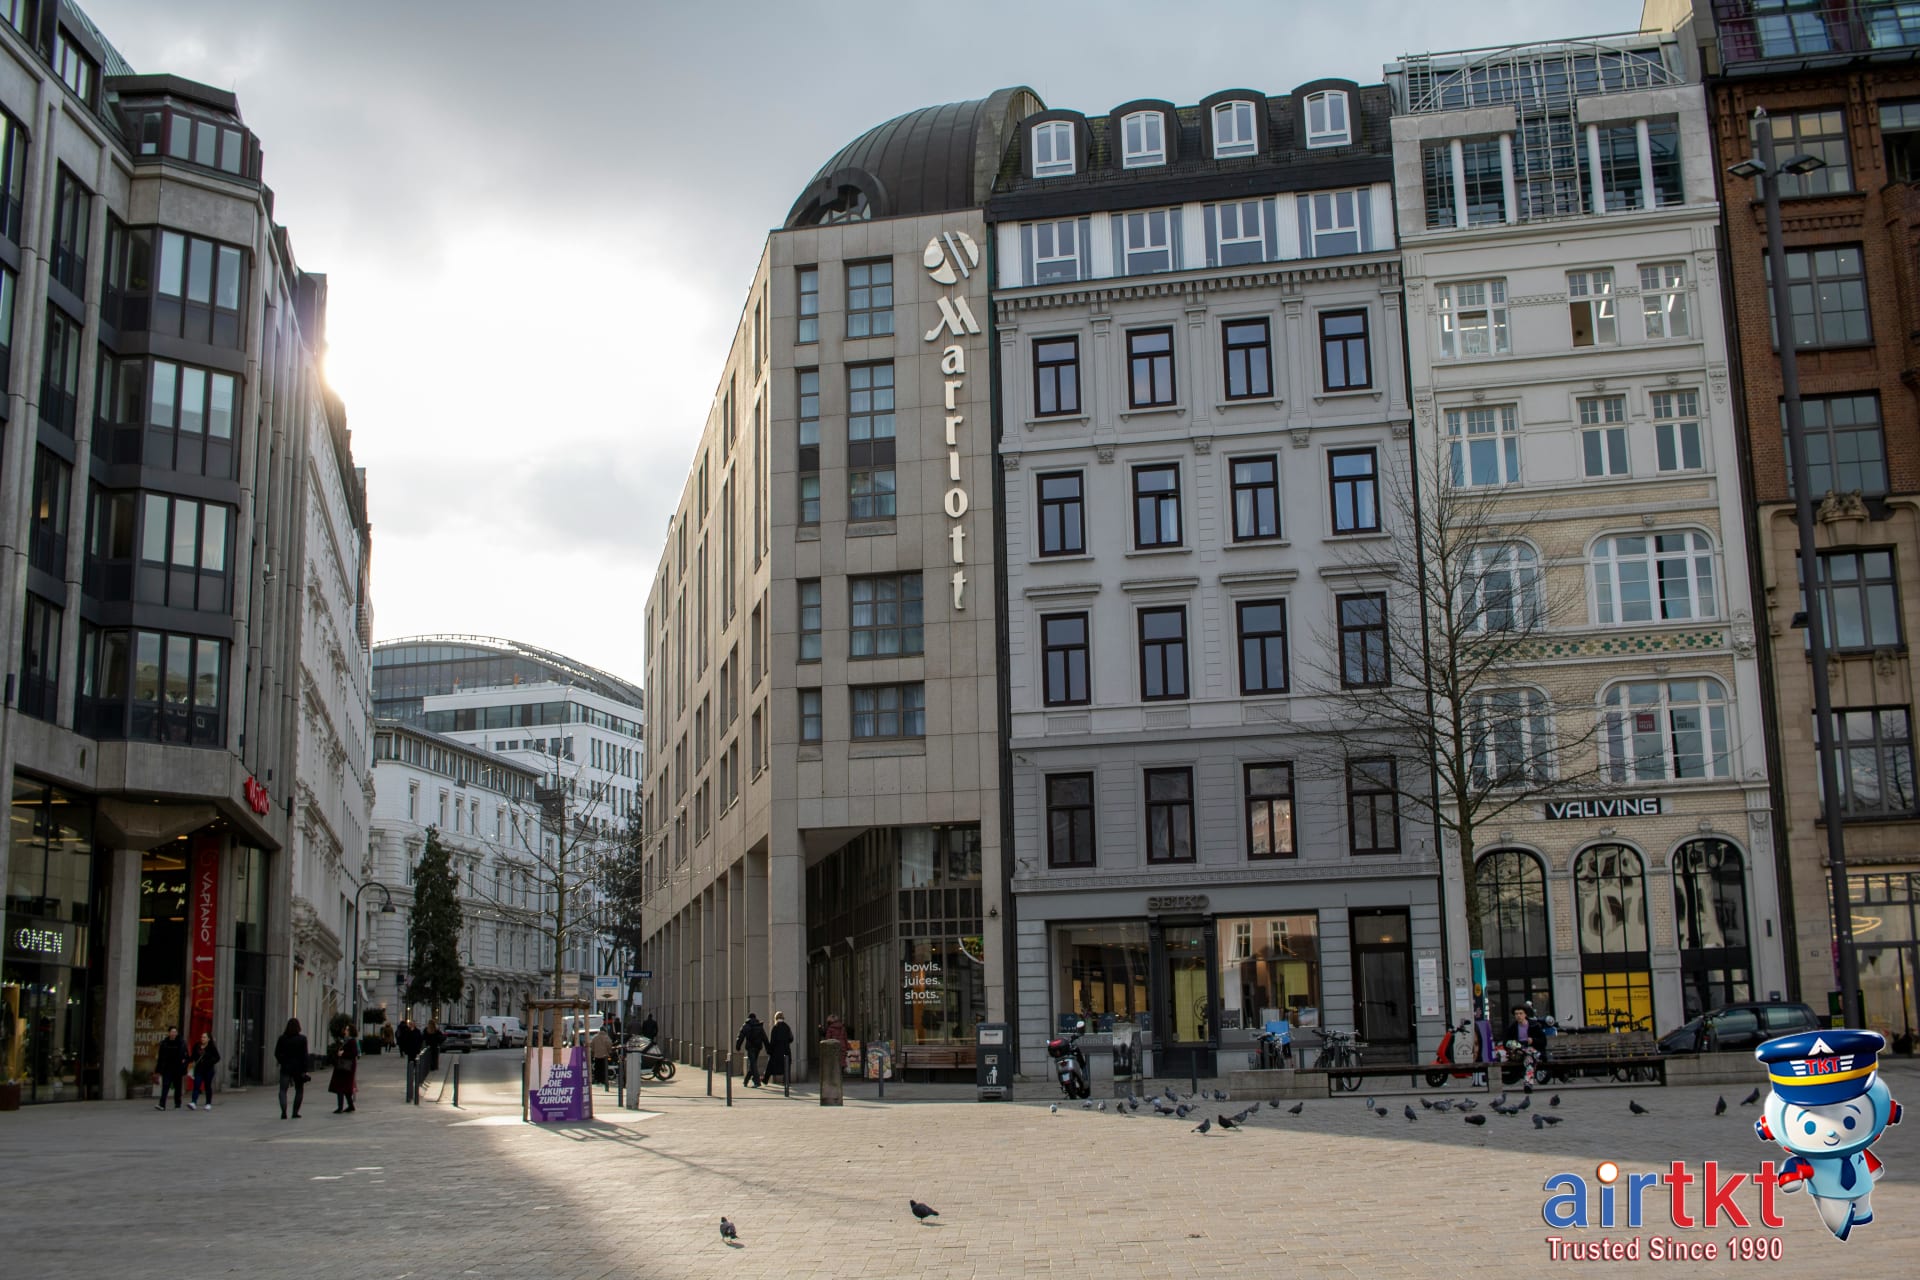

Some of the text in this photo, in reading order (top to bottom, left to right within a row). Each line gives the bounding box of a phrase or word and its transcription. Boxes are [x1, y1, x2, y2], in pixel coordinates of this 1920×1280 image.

[924, 296, 981, 611] Marriott
[1549, 798, 1658, 819] VALIVING
[200, 872, 213, 943] VAPIANO
[20, 928, 63, 953] OMEN
[904, 961, 941, 972] bowls.
[903, 976, 941, 988] juices.
[904, 990, 940, 1000] shots.
[537, 1087, 575, 1096] ZUKUNFT
